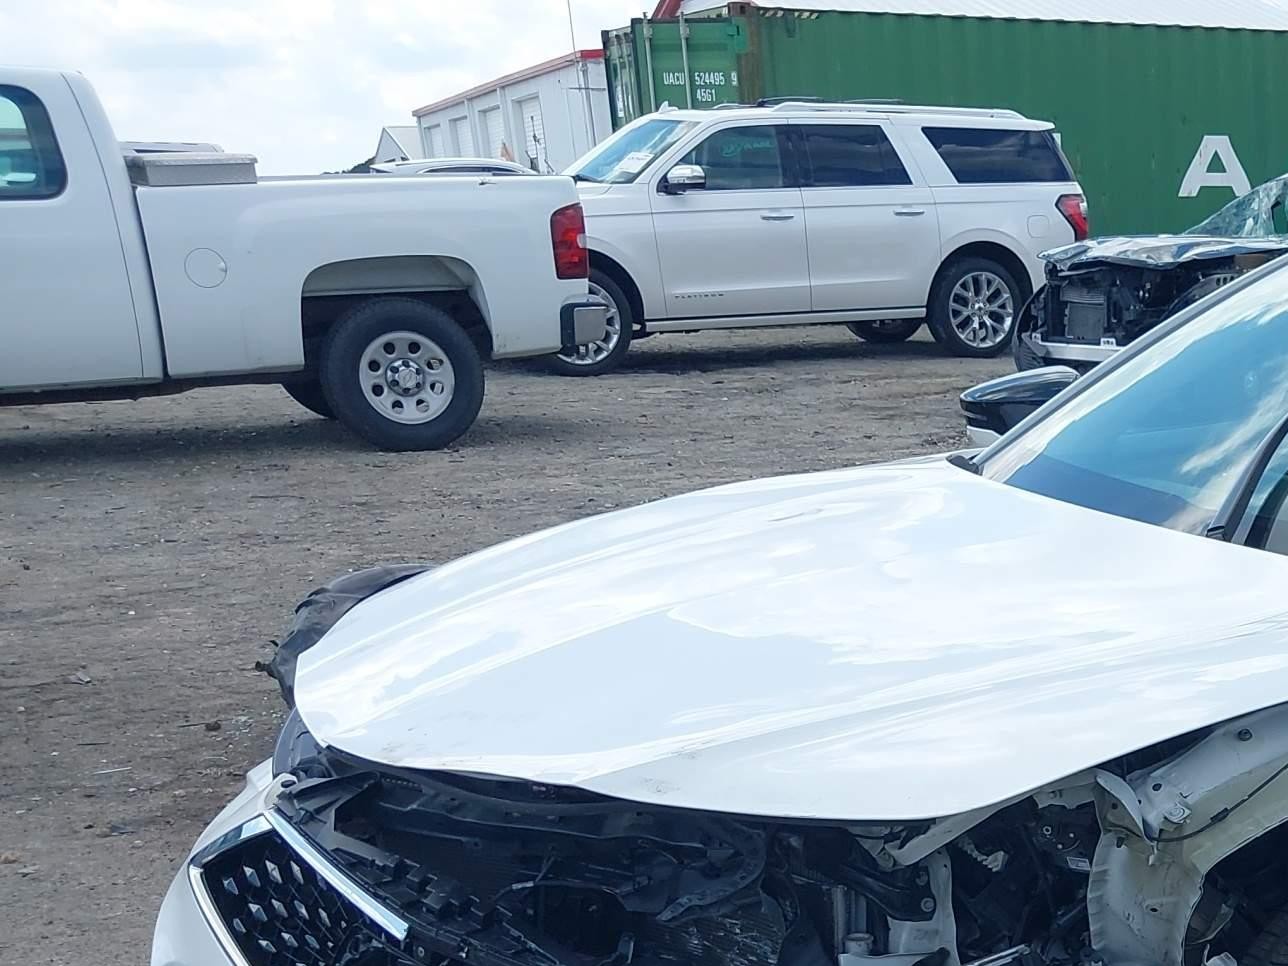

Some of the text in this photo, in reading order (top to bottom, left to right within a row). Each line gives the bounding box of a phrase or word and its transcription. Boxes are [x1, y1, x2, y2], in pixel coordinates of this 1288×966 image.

[663, 71, 685, 85] UACU
[694, 71, 725, 86] 524495
[696, 88, 716, 102] 45G1
